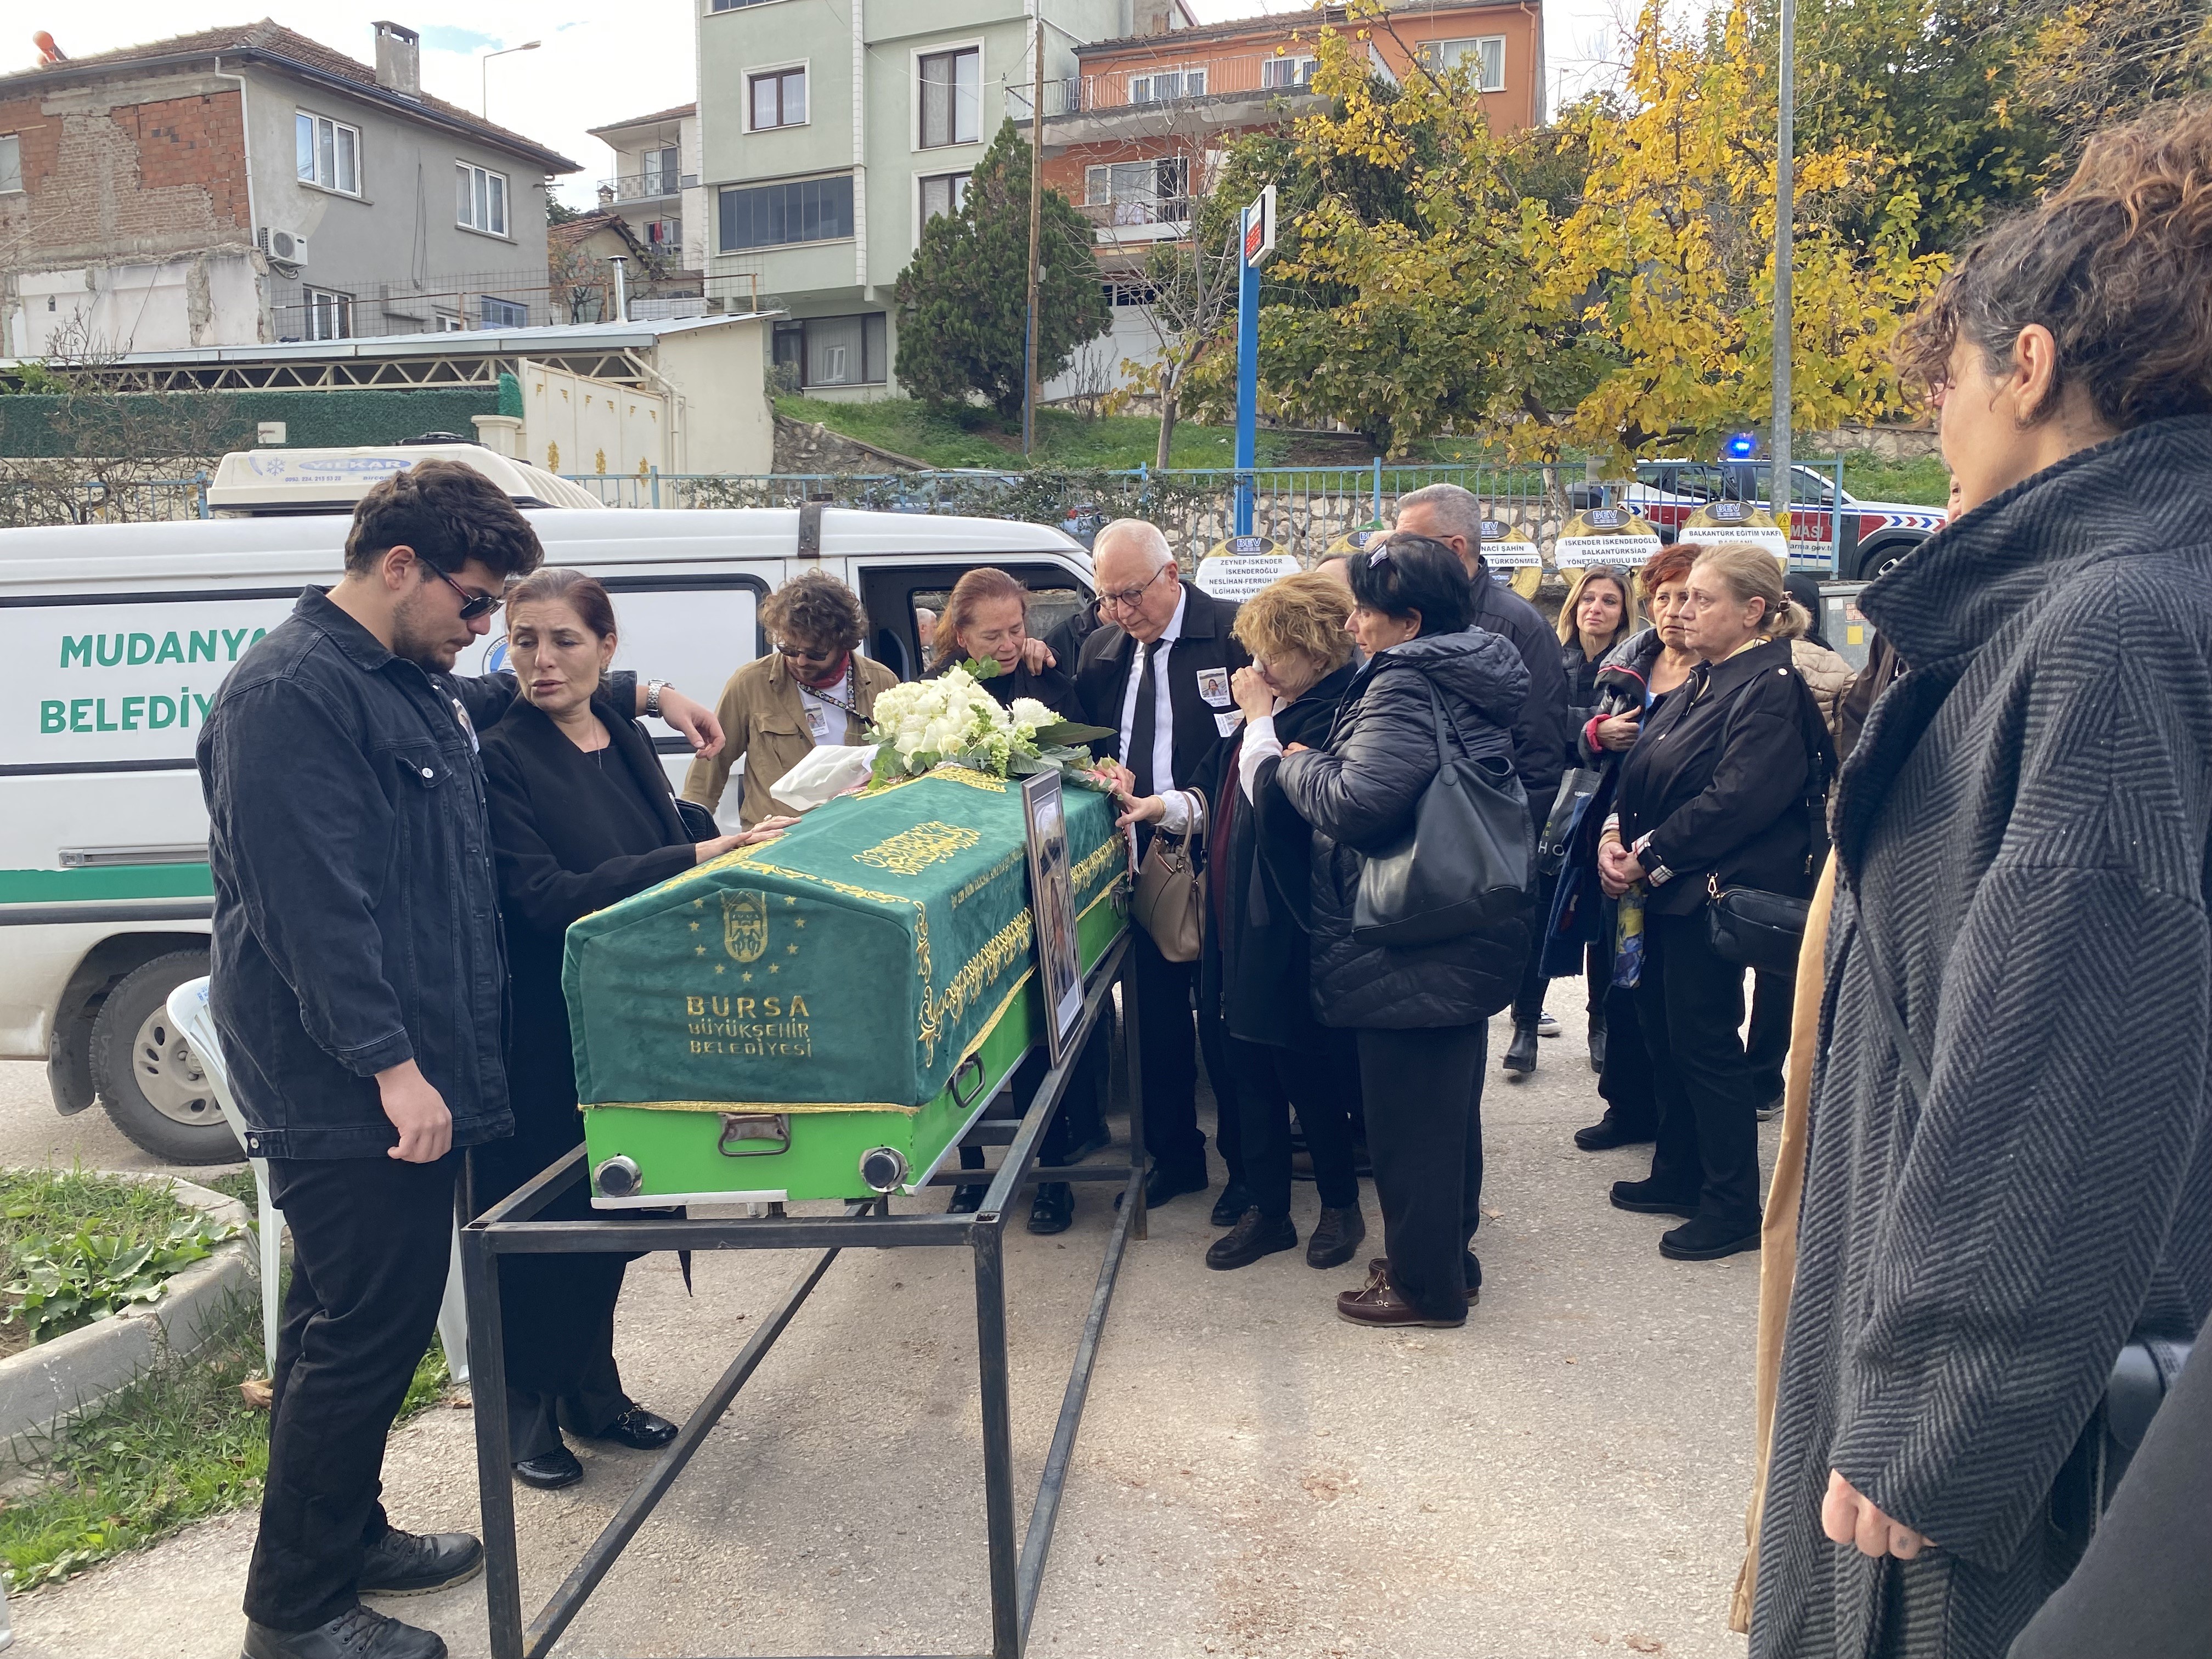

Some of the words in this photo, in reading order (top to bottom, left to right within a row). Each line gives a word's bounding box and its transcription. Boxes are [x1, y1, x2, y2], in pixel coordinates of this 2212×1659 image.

[1593, 510, 1617, 519] BEV
[1716, 503, 1741, 512] BEV
[1237, 538, 1262, 547] BEV
[488, 637, 508, 657] MUDAN
[686, 995, 809, 1019] BURSA
[688, 1018, 809, 1040] BÜYÜKŞEHİR
[690, 1038, 812, 1057] BELEDİYESİ
